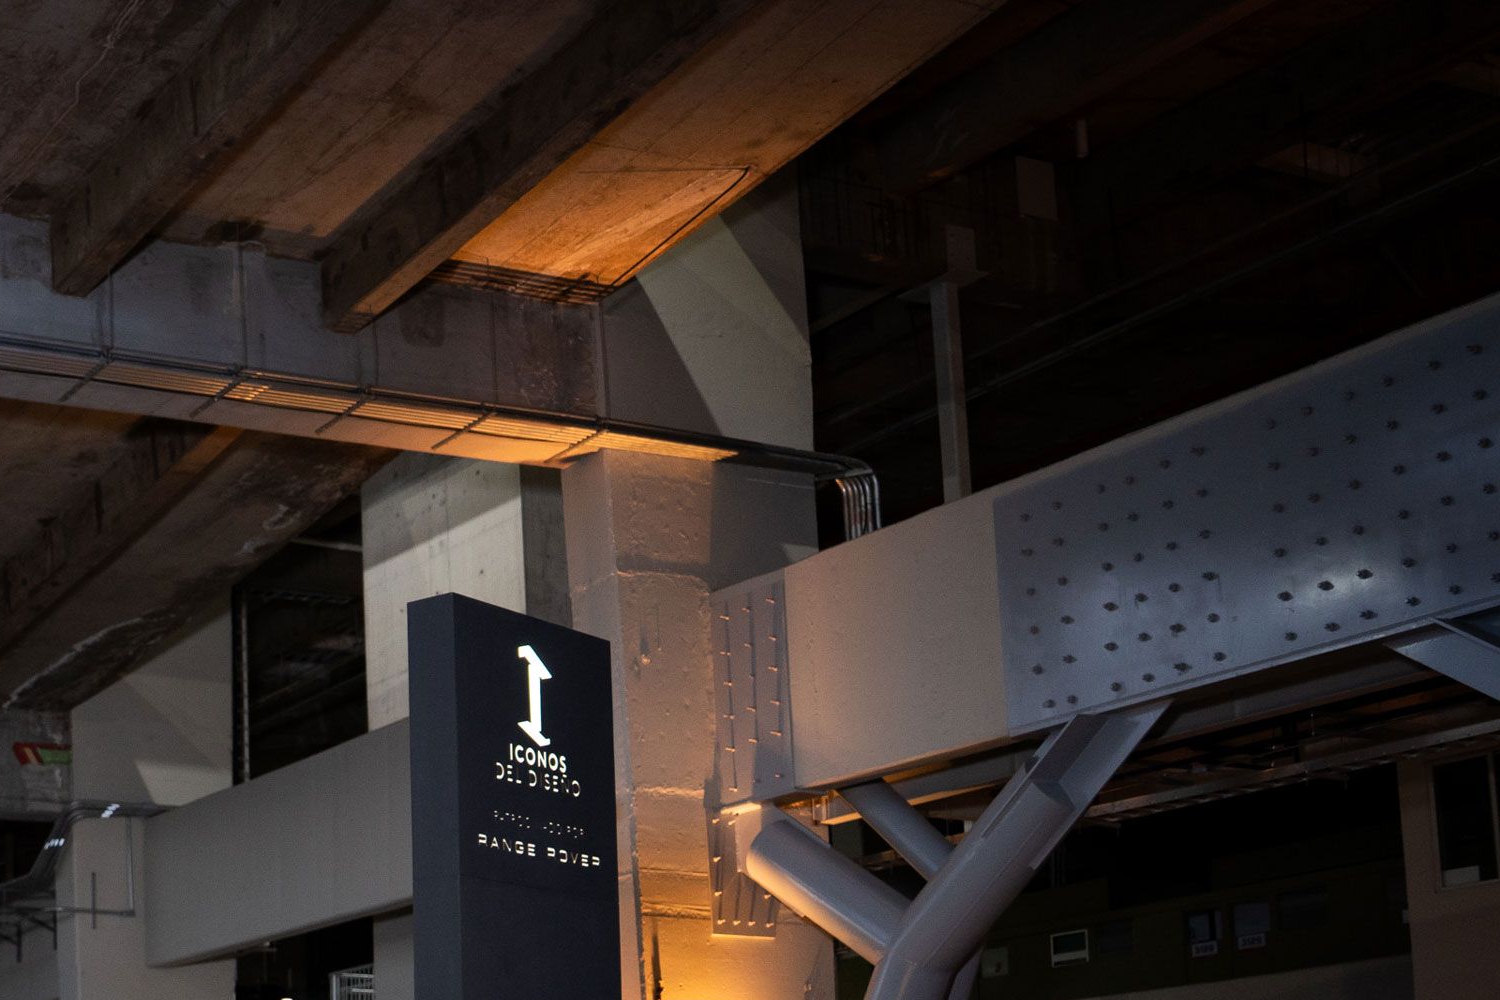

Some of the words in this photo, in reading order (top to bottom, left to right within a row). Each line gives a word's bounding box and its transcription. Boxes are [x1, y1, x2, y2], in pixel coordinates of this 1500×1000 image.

[509, 743, 567, 774] ICONOS
[495, 761, 523, 785] DEL
[528, 770, 581, 798] DISEÑO
[478, 832, 537, 858] RANGE
[546, 846, 602, 869] ROVER
